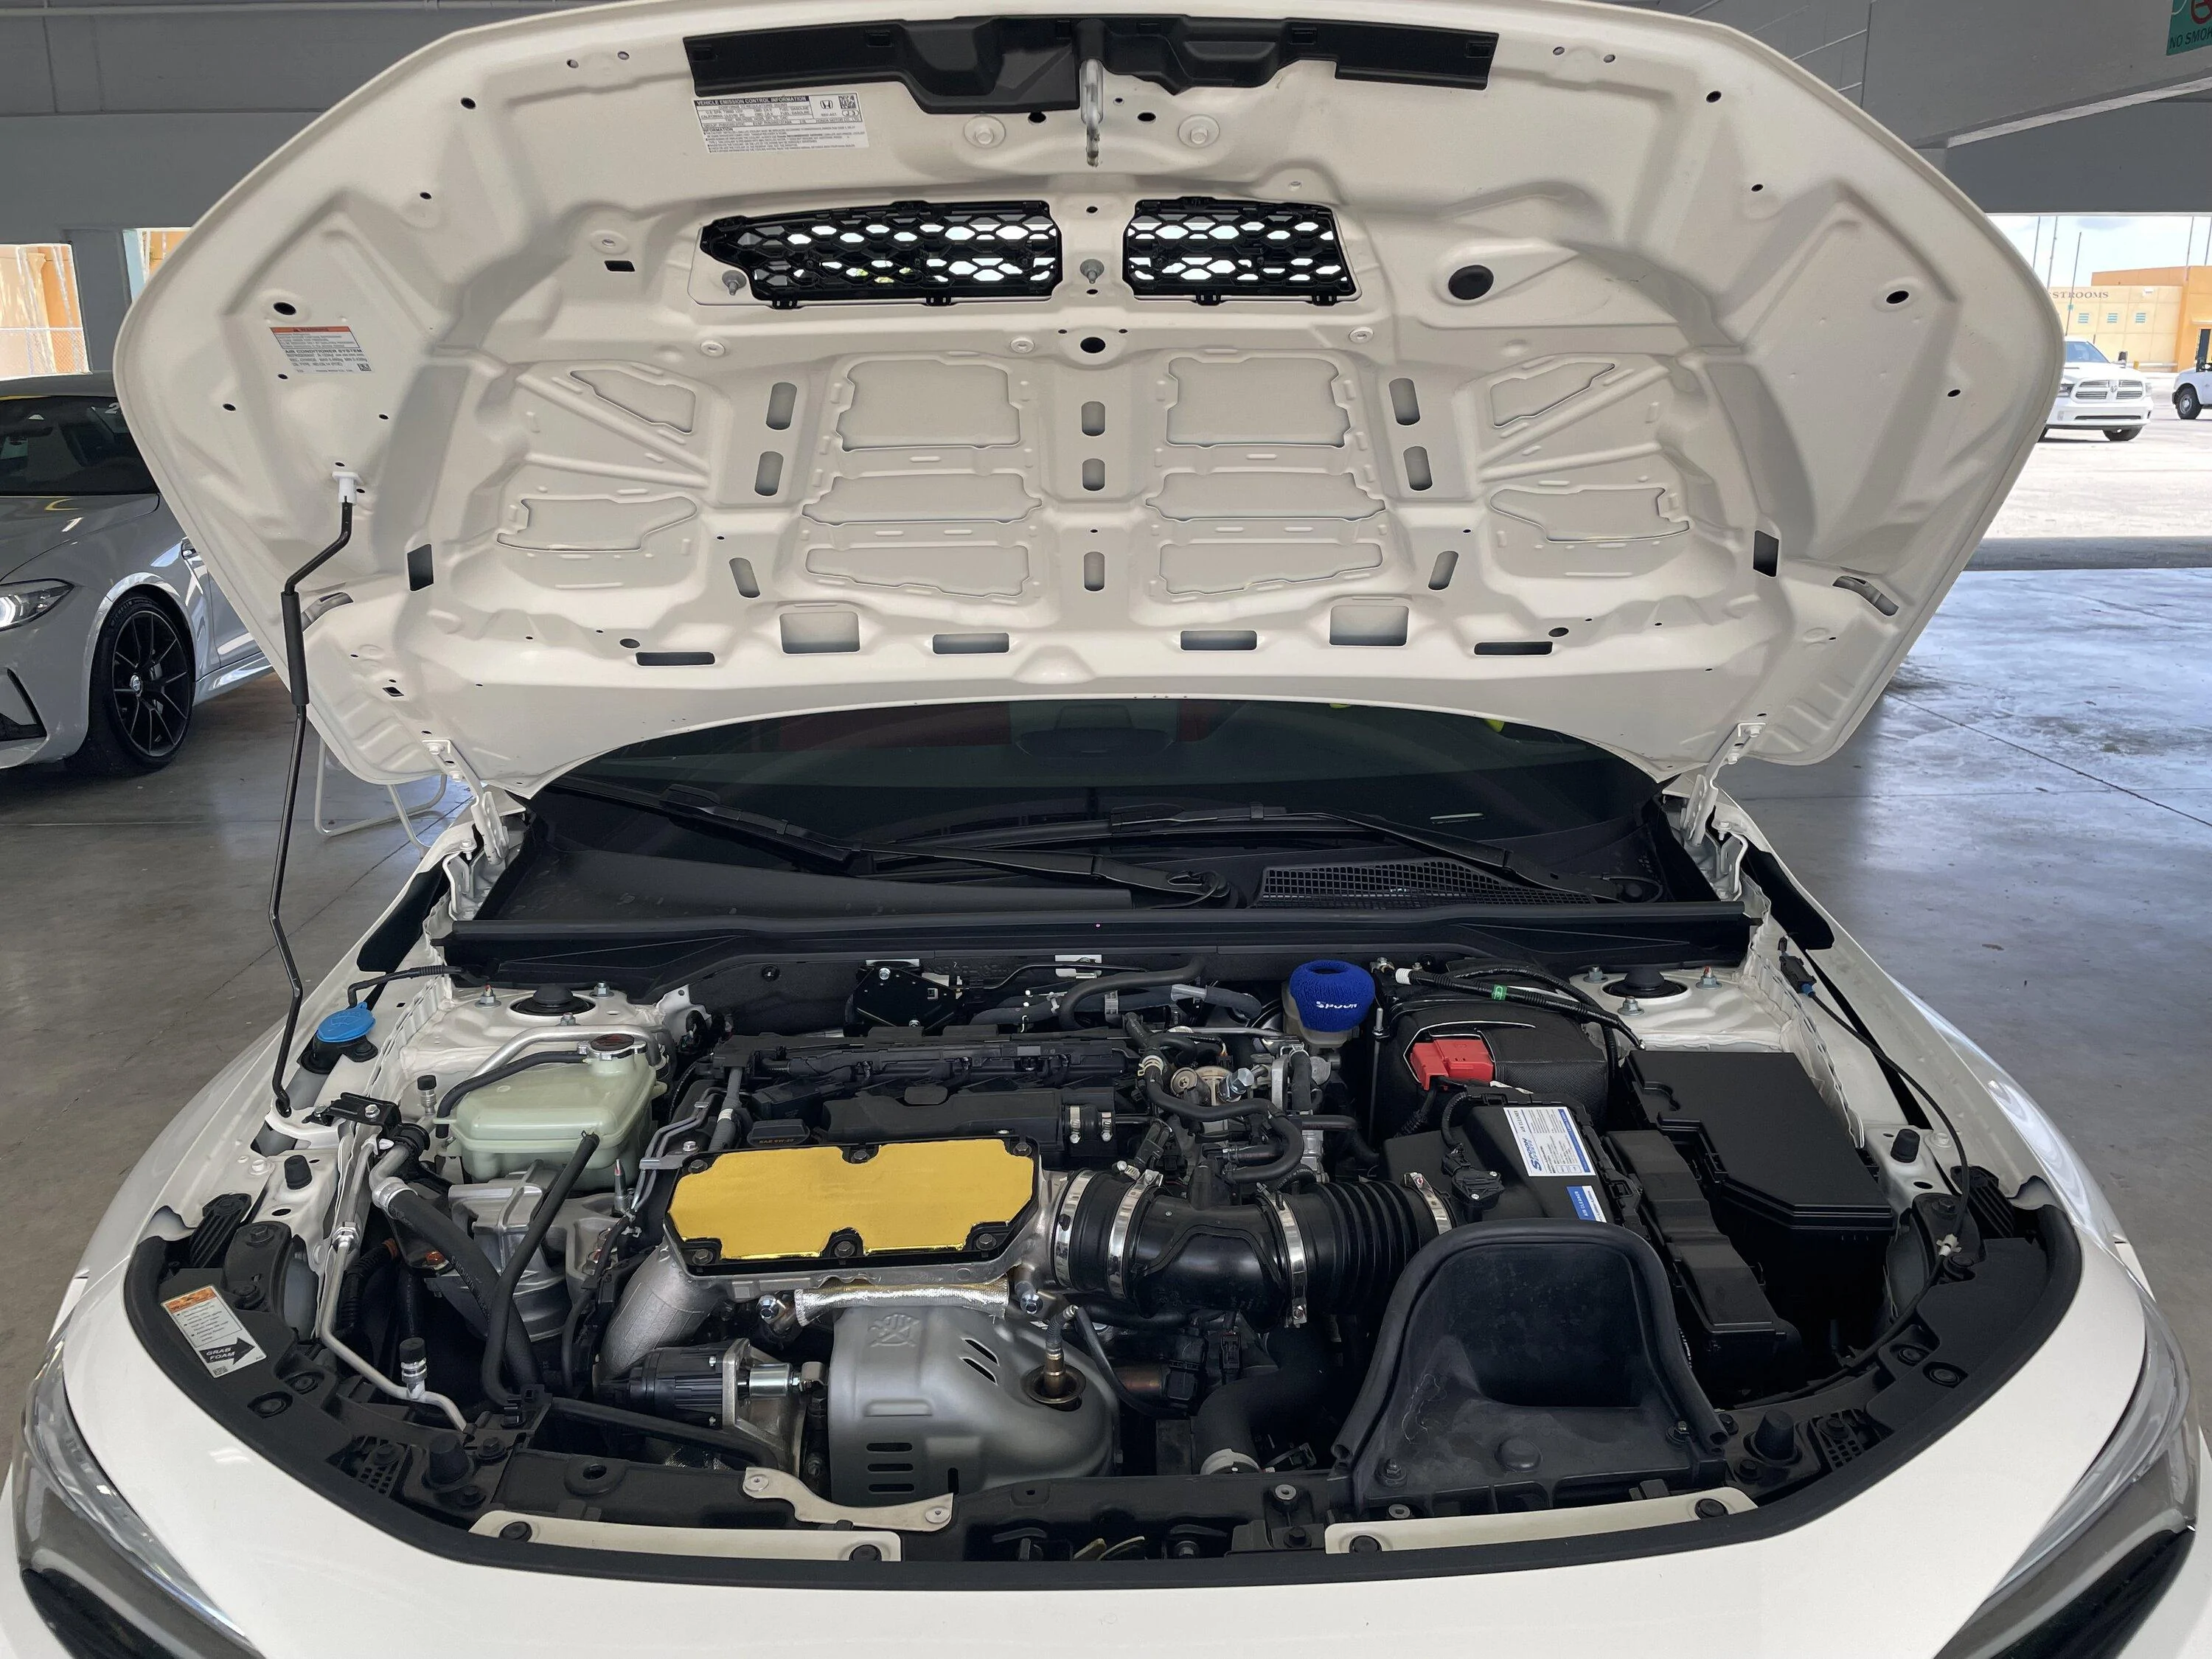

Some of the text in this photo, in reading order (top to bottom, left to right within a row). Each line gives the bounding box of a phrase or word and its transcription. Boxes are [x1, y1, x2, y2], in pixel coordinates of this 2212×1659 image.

[2169, 35, 2183, 49] NO
[105, 402, 120, 414] 2
[1513, 1110, 1523, 1127] CLEANER
[1574, 1191, 1585, 1209] CLEANER
[206, 1347, 236, 1361] GRAB FOAM
